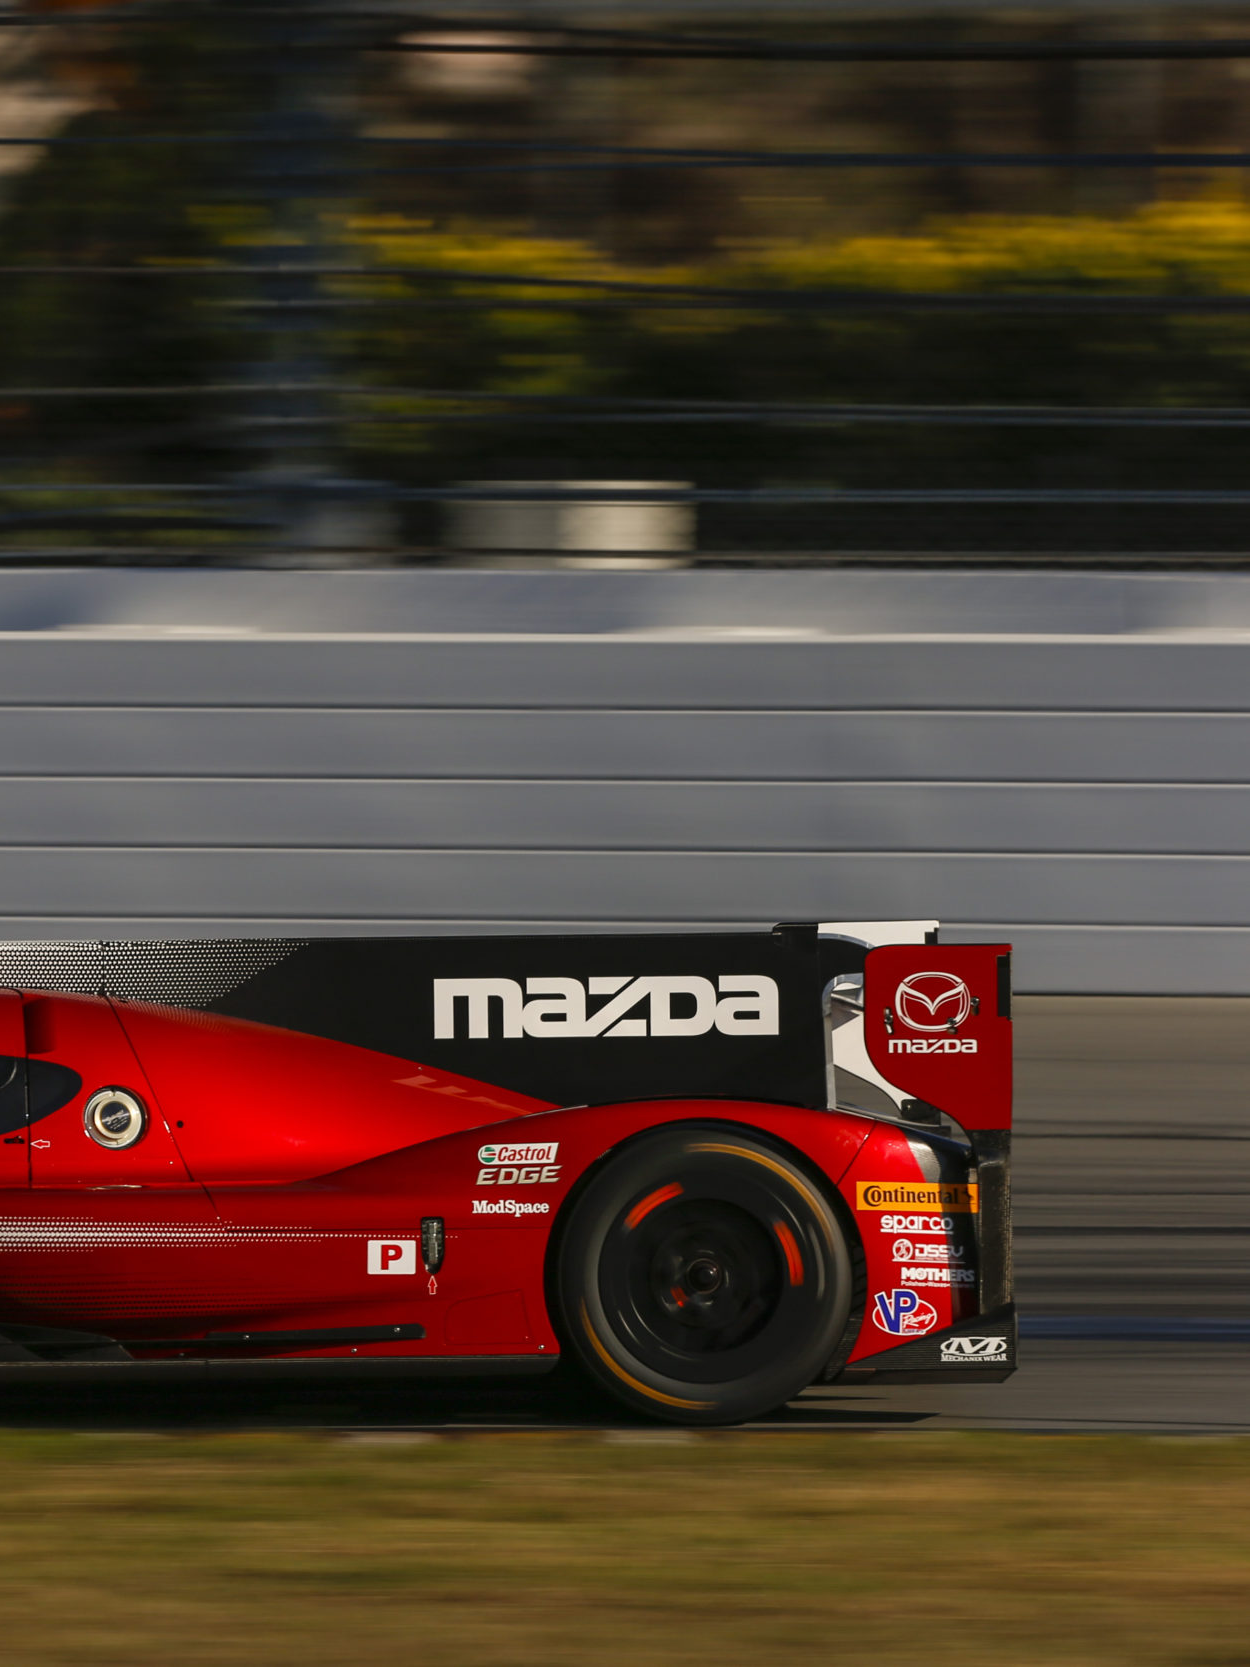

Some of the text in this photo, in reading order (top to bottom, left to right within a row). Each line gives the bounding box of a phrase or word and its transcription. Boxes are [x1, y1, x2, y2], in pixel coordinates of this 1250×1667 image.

[497, 1145, 552, 1162] Castrol
[475, 1165, 563, 1185] EDGE
[863, 1185, 959, 1207] Continental
[471, 1199, 550, 1217] ModSpace
[880, 1214, 954, 1233] sparco
[380, 1244, 403, 1270] P
[901, 1267, 975, 1282] MOTHERS
[874, 1288, 919, 1335] VP
[983, 1353, 1007, 1362] WEAR
